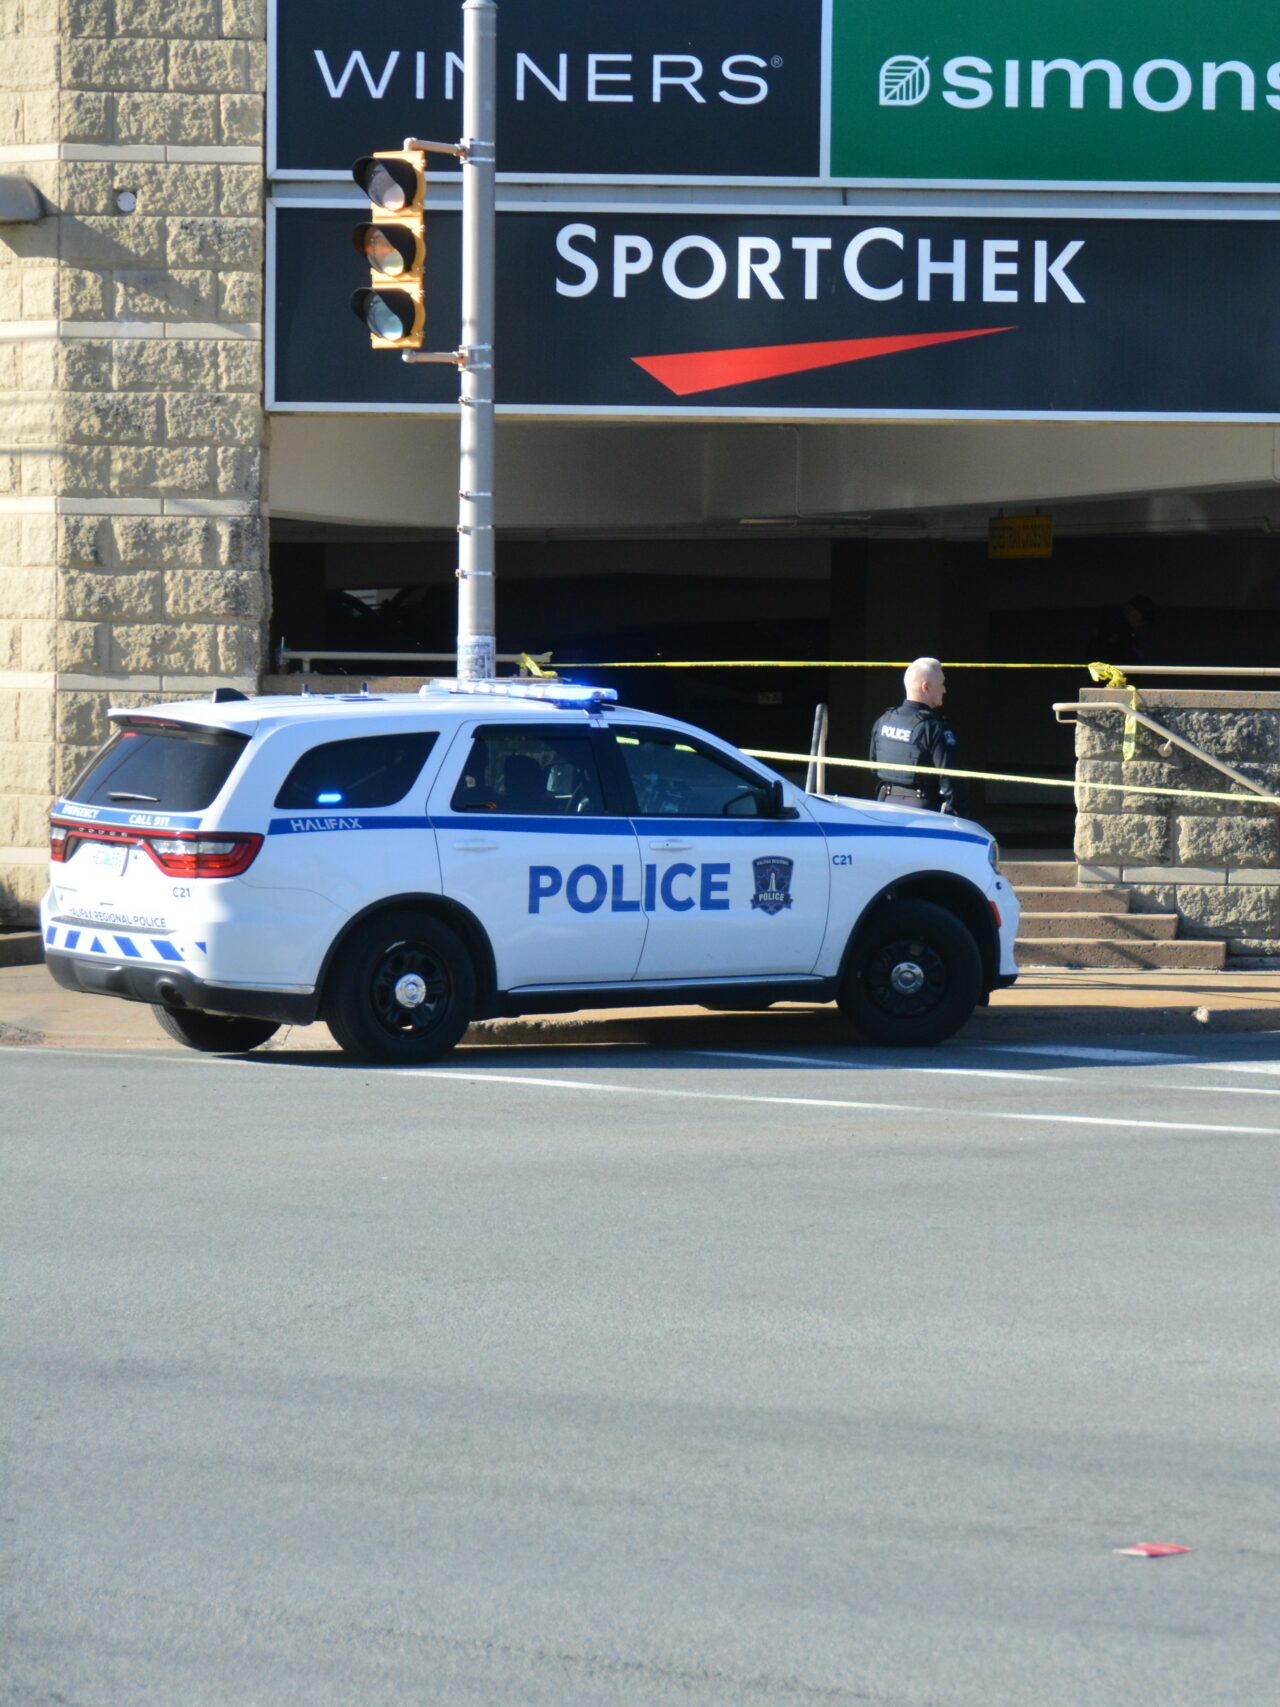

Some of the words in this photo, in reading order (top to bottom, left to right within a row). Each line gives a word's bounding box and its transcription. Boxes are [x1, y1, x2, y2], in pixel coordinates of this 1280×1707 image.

[881, 724, 911, 742] POLICE
[128, 813, 152, 826] CALL
[153, 815, 170, 827] 911
[290, 818, 363, 832] HALIFAX
[832, 854, 853, 866] C21
[172, 886, 191, 898] C21
[528, 863, 731, 914] POLICE
[758, 892, 785, 902] POLICE
[94, 910, 132, 925] REGIONAL
[133, 915, 167, 928] POLICE
